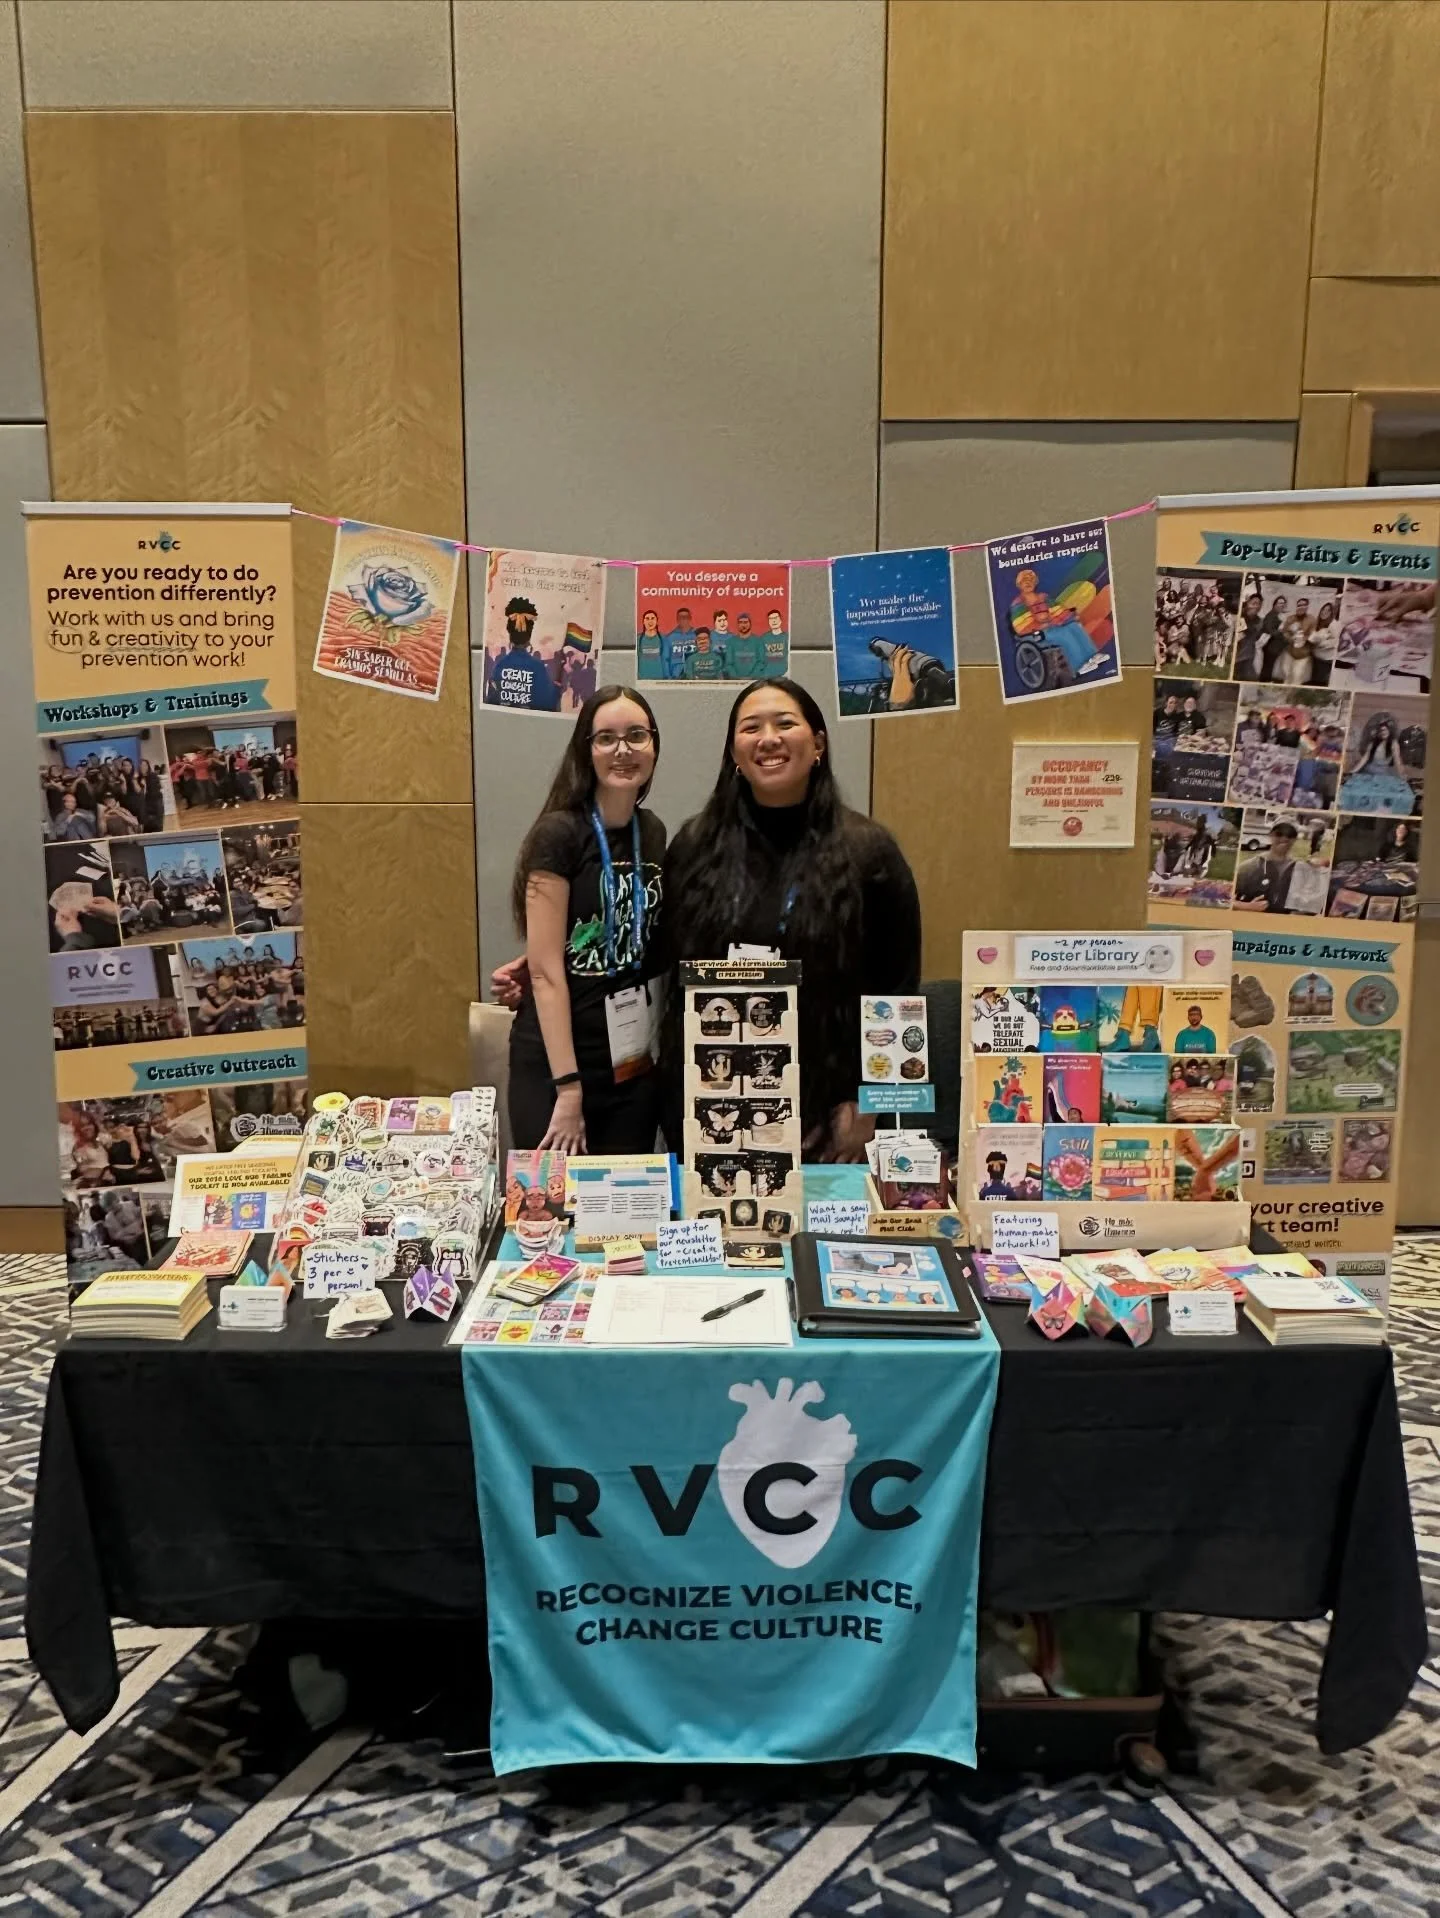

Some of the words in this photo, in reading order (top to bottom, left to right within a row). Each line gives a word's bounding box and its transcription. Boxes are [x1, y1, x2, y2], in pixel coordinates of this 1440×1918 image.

[1372, 522, 1422, 534] RVCC
[138, 540, 181, 550] RVCC
[990, 546, 1007, 556] We
[1010, 539, 1047, 553] deserve
[1051, 536, 1060, 545] to
[1062, 531, 1086, 543] have
[1088, 528, 1103, 537] our
[998, 551, 1054, 569] boundaries
[1056, 541, 1099, 557] respected
[1220, 539, 1288, 564] Pop-Up
[1294, 545, 1342, 564] Fairs
[1347, 549, 1361, 565] &
[1368, 550, 1432, 571] Events
[63, 565, 97, 580] Are
[102, 568, 137, 583] you
[144, 565, 202, 583] ready
[208, 567, 227, 580] to
[233, 565, 258, 580] do
[667, 571, 692, 582] You
[695, 571, 747, 582] deserve
[750, 572, 758, 582] a
[47, 587, 154, 604] prevention
[160, 585, 276, 604] differently?
[641, 586, 714, 599] community
[716, 586, 730, 596] of
[733, 586, 784, 599] support
[860, 598, 876, 607] We
[879, 595, 905, 605] make
[909, 593, 924, 602] the
[846, 605, 899, 620] impossible
[901, 602, 941, 616] possible
[48, 610, 98, 626] Work
[105, 610, 144, 626] with
[151, 613, 174, 626] us
[180, 611, 216, 626] and
[224, 611, 274, 629] bring
[51, 630, 83, 646] fun
[89, 631, 100, 646] &
[106, 631, 198, 650] creativity
[205, 632, 223, 647] to
[230, 633, 274, 650] your
[81, 652, 187, 669] prevention
[192, 652, 246, 667] work!
[502, 668, 534, 683] CREATE
[500, 680, 533, 692] CONSENT
[500, 690, 532, 705] CULTURE
[44, 701, 138, 724] Workshops
[146, 698, 159, 712] &
[164, 689, 249, 712] Trainings
[1031, 950, 1081, 962] Poster
[1085, 949, 1139, 963] Library
[1233, 940, 1296, 957] mpaigns
[1302, 943, 1314, 957] &
[1320, 946, 1389, 963] Artwork
[68, 962, 133, 980] RVCC
[993, 1038, 1025, 1046] SEXUAL
[147, 1063, 215, 1082] Creative
[221, 1054, 298, 1075] Outreach
[810, 1204, 836, 1213] Want
[1251, 1202, 1295, 1217] your
[1299, 1198, 1384, 1213] creative
[811, 1215, 831, 1223] mail
[994, 1215, 1043, 1226] Featuring
[1281, 1217, 1339, 1233] team!
[660, 1226, 678, 1239] Sign
[681, 1226, 691, 1236] up
[693, 1224, 709, 1232] for
[676, 1236, 717, 1245] newsletter
[660, 1247, 672, 1257] for
[308, 1267, 317, 1279] 3
[324, 1270, 341, 1282] per
[328, 1279, 363, 1293] person!
[531, 1459, 923, 1539] RVCC
[536, 1582, 731, 1613] RECOGNIZE
[741, 1579, 922, 1614] VIOLENCE,
[576, 1619, 719, 1646] CHANGE
[729, 1615, 883, 1644] CULTURE
